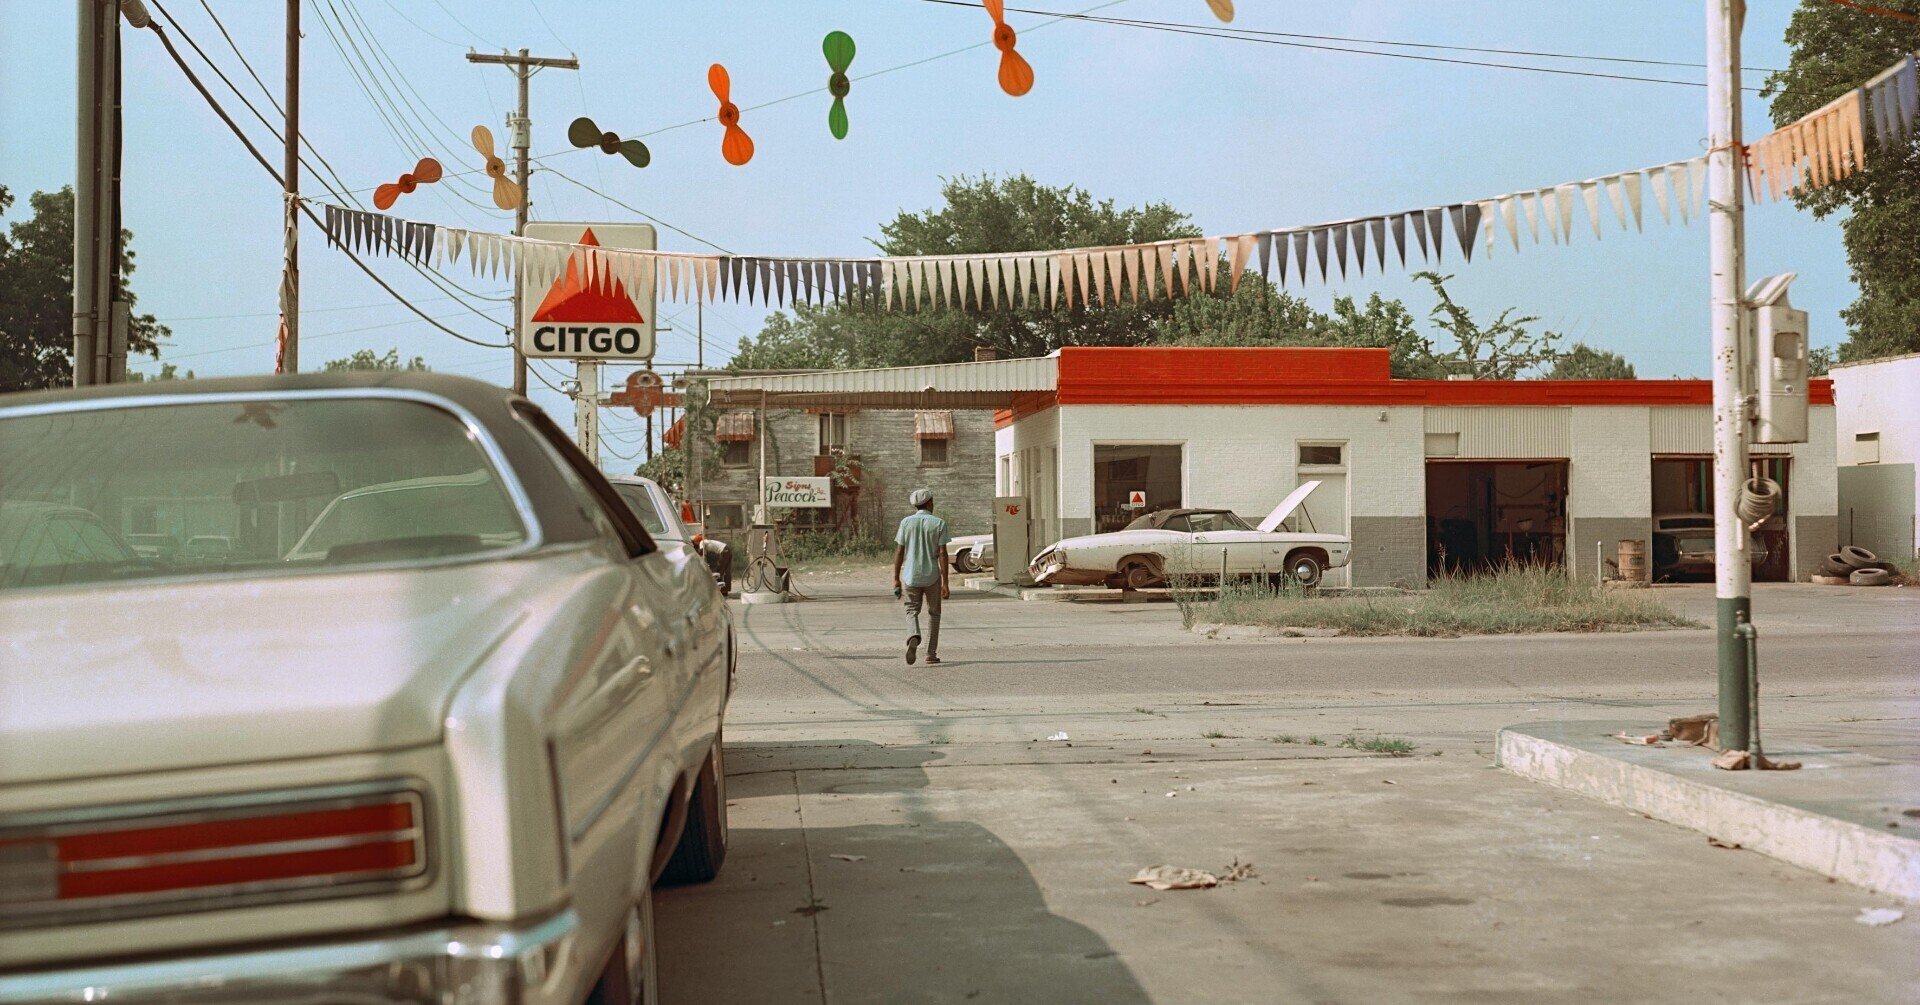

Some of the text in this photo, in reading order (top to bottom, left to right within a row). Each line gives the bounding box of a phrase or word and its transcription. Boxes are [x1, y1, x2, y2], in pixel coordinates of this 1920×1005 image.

[533, 326, 640, 354] CITGO
[765, 481, 816, 502] Peacock
[786, 481, 811, 492] Signs
